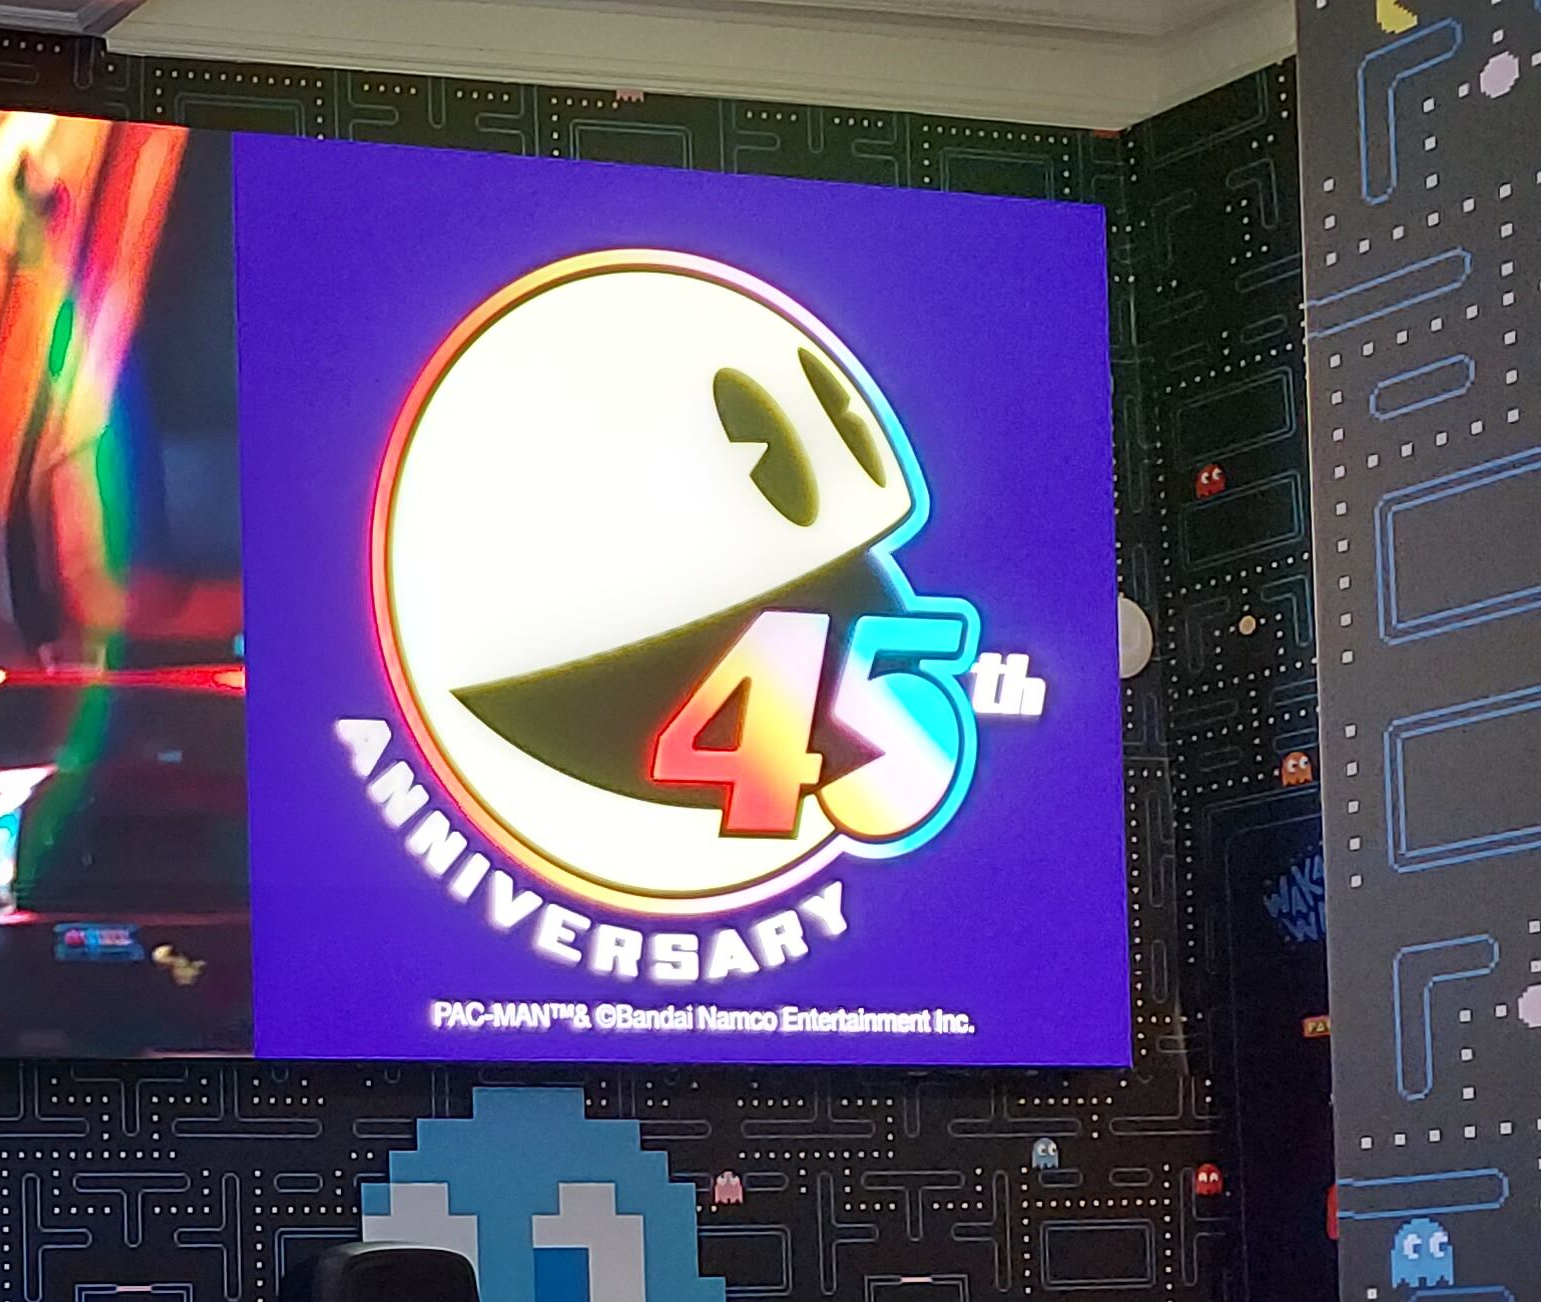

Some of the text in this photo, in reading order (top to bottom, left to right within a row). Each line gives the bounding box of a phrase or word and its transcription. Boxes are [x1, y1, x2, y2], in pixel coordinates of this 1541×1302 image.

[335, 718, 849, 984] ANNIVERSARY
[697, 1005, 779, 1032] Namco
[780, 1006, 932, 1033] Entertainment
[935, 1008, 976, 1035] Inc.
